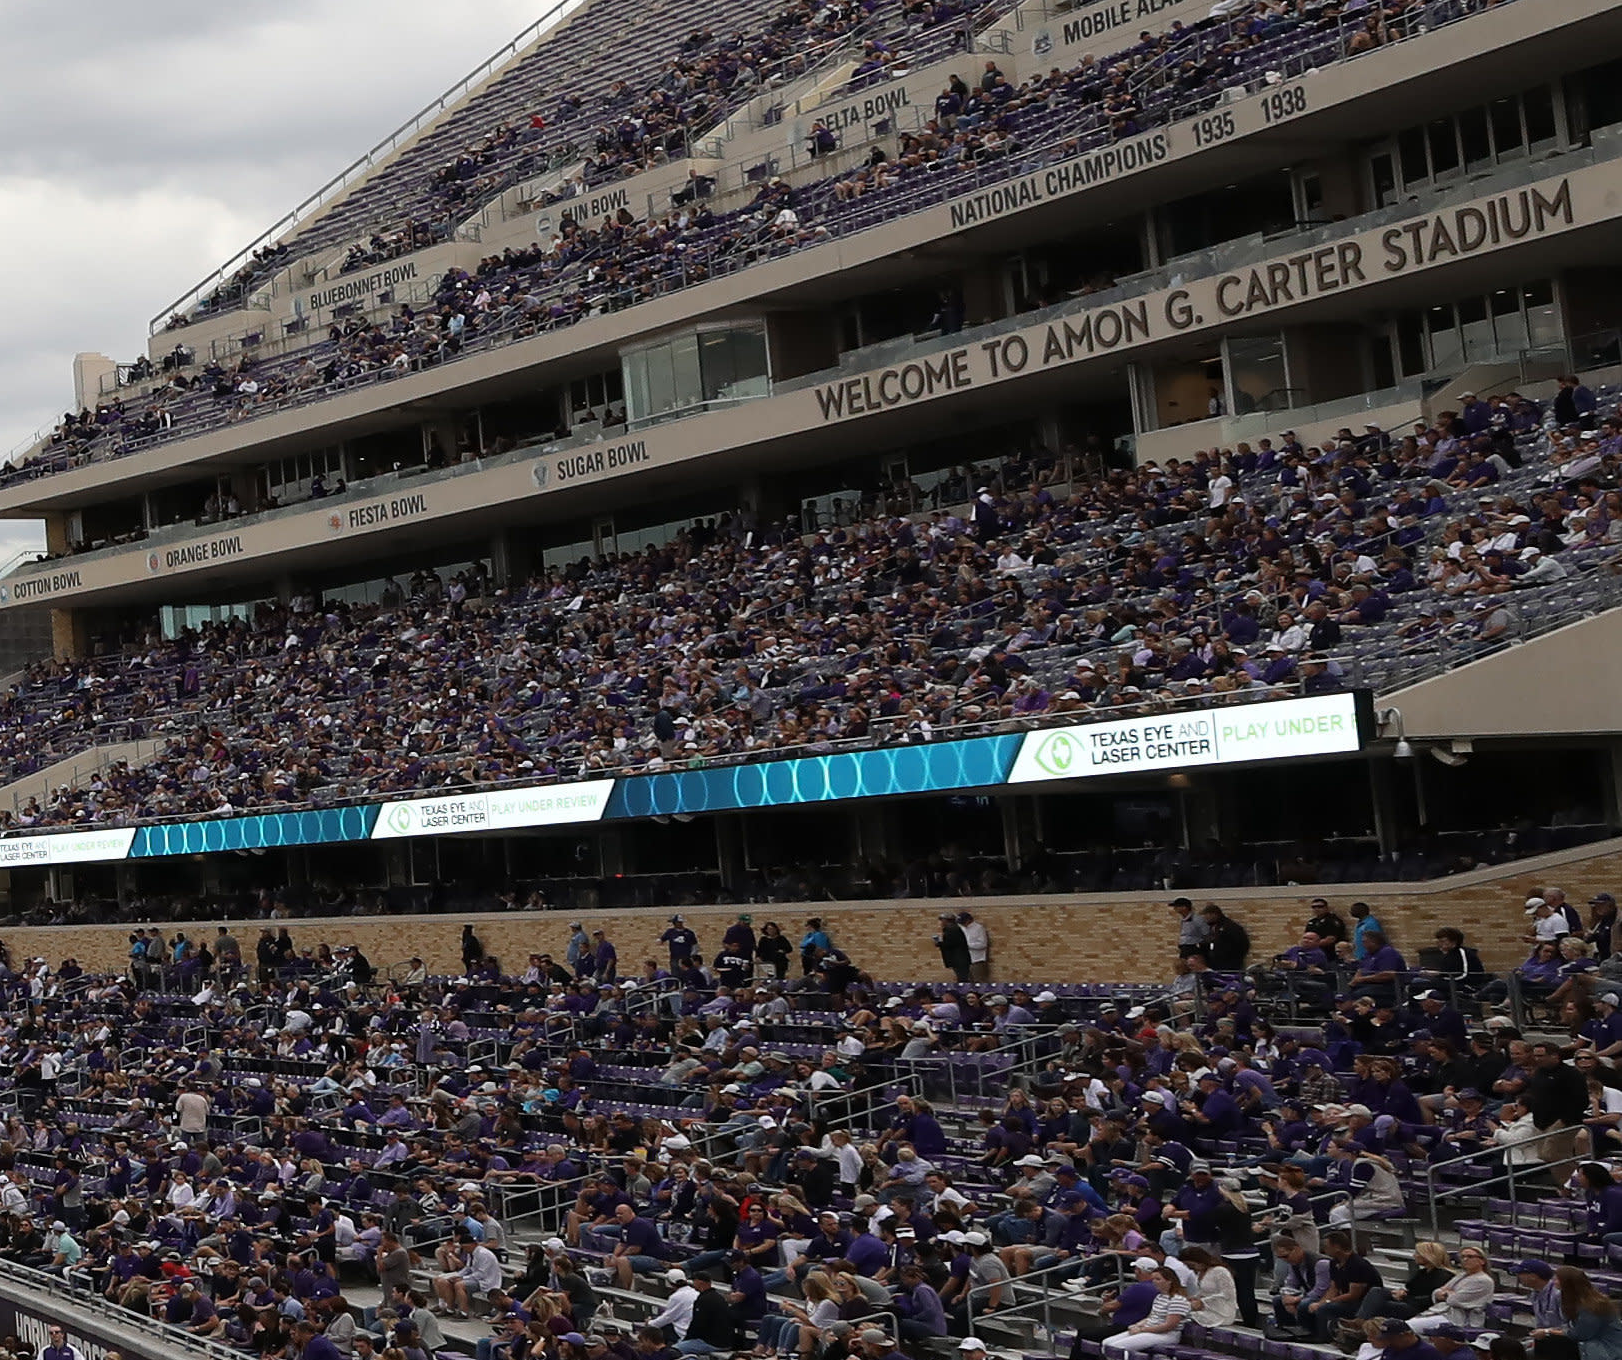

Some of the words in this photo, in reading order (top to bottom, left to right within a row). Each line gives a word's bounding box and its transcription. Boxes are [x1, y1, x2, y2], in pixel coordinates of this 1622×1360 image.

[1063, 2, 1131, 45] MOBILE
[864, 88, 912, 120] BOWL
[1192, 110, 1234, 147] 1935
[1260, 85, 1306, 123] 1938
[950, 175, 1042, 229] NATIONAL
[1046, 134, 1168, 197] CHAMPIONS
[592, 188, 630, 215] BOWL
[311, 272, 383, 310] BLUEBONNET
[384, 263, 418, 289] BOWL
[815, 350, 973, 421] WELCOME
[982, 338, 1029, 378] TO
[1043, 300, 1149, 365] AMON
[1165, 289, 1203, 329] G.
[1215, 241, 1366, 317] CARTER
[1382, 179, 1574, 272] STADIUM
[557, 450, 604, 481] SUGAR
[608, 441, 649, 468] BOWL
[349, 503, 388, 528] FIESTA
[391, 494, 427, 519] BOWL
[167, 543, 208, 568] ORANGE
[211, 536, 243, 560] BOWL
[14, 577, 51, 600] COTTON
[52, 571, 82, 595] BOWL
[1090, 731, 1138, 748] TEXAS
[1143, 725, 1173, 742] EYE
[1179, 720, 1209, 737] AND
[1222, 722, 1269, 742] PLAY
[1276, 714, 1343, 736] UNDER
[1091, 748, 1140, 766] LASER
[1145, 740, 1211, 760] CENTER
[421, 805, 448, 815] TEXAS
[450, 803, 466, 813] EYE
[491, 802, 515, 815] PLAY
[518, 799, 553, 813] UNDER
[557, 794, 598, 809] REVIEW
[421, 816, 449, 828] LASER
[451, 812, 486, 826] CENTER
